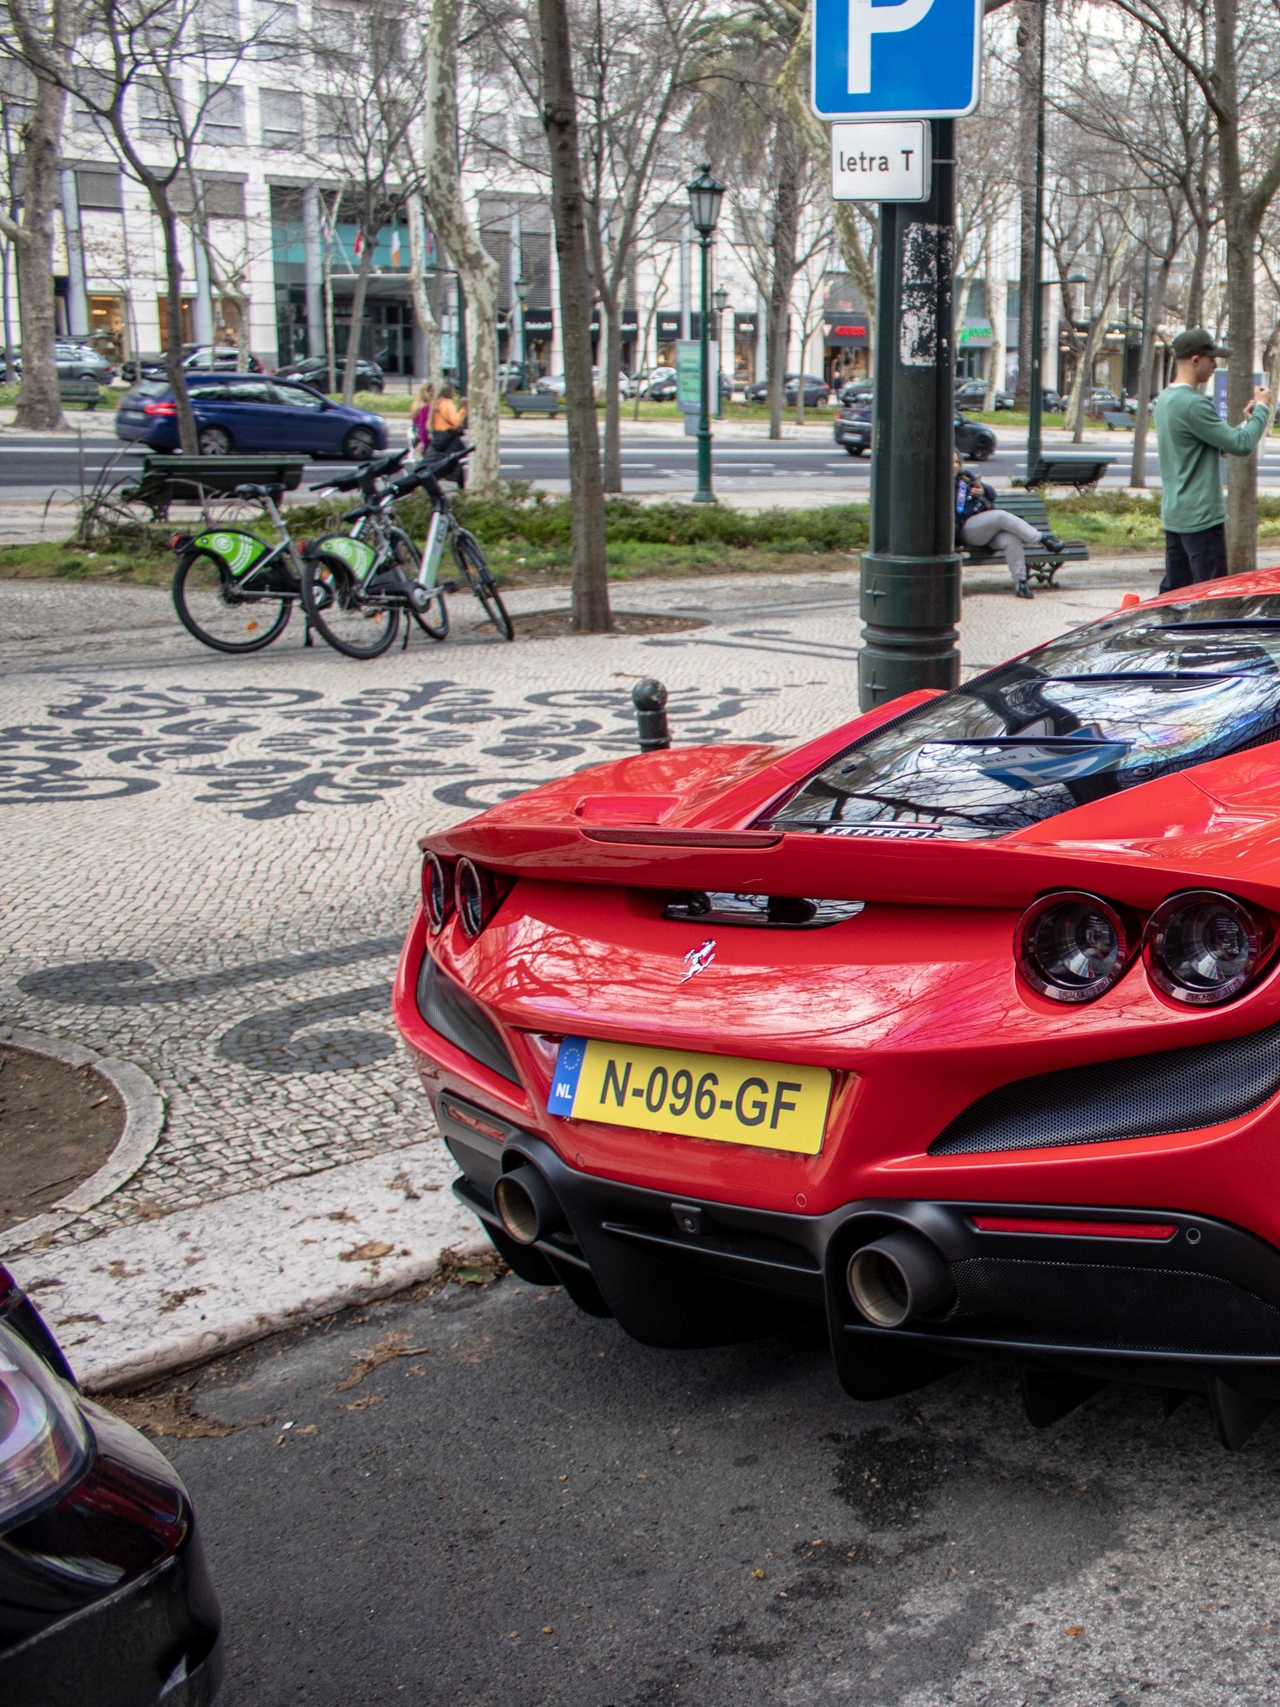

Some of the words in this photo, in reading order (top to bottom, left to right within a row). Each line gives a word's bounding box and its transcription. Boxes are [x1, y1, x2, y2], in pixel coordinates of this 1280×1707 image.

[839, 151, 889, 172] letra
[901, 150, 915, 171] T
[835, 326, 866, 336] GUESS
[555, 1082, 573, 1100] NL
[598, 1059, 803, 1130] N-096-GF
